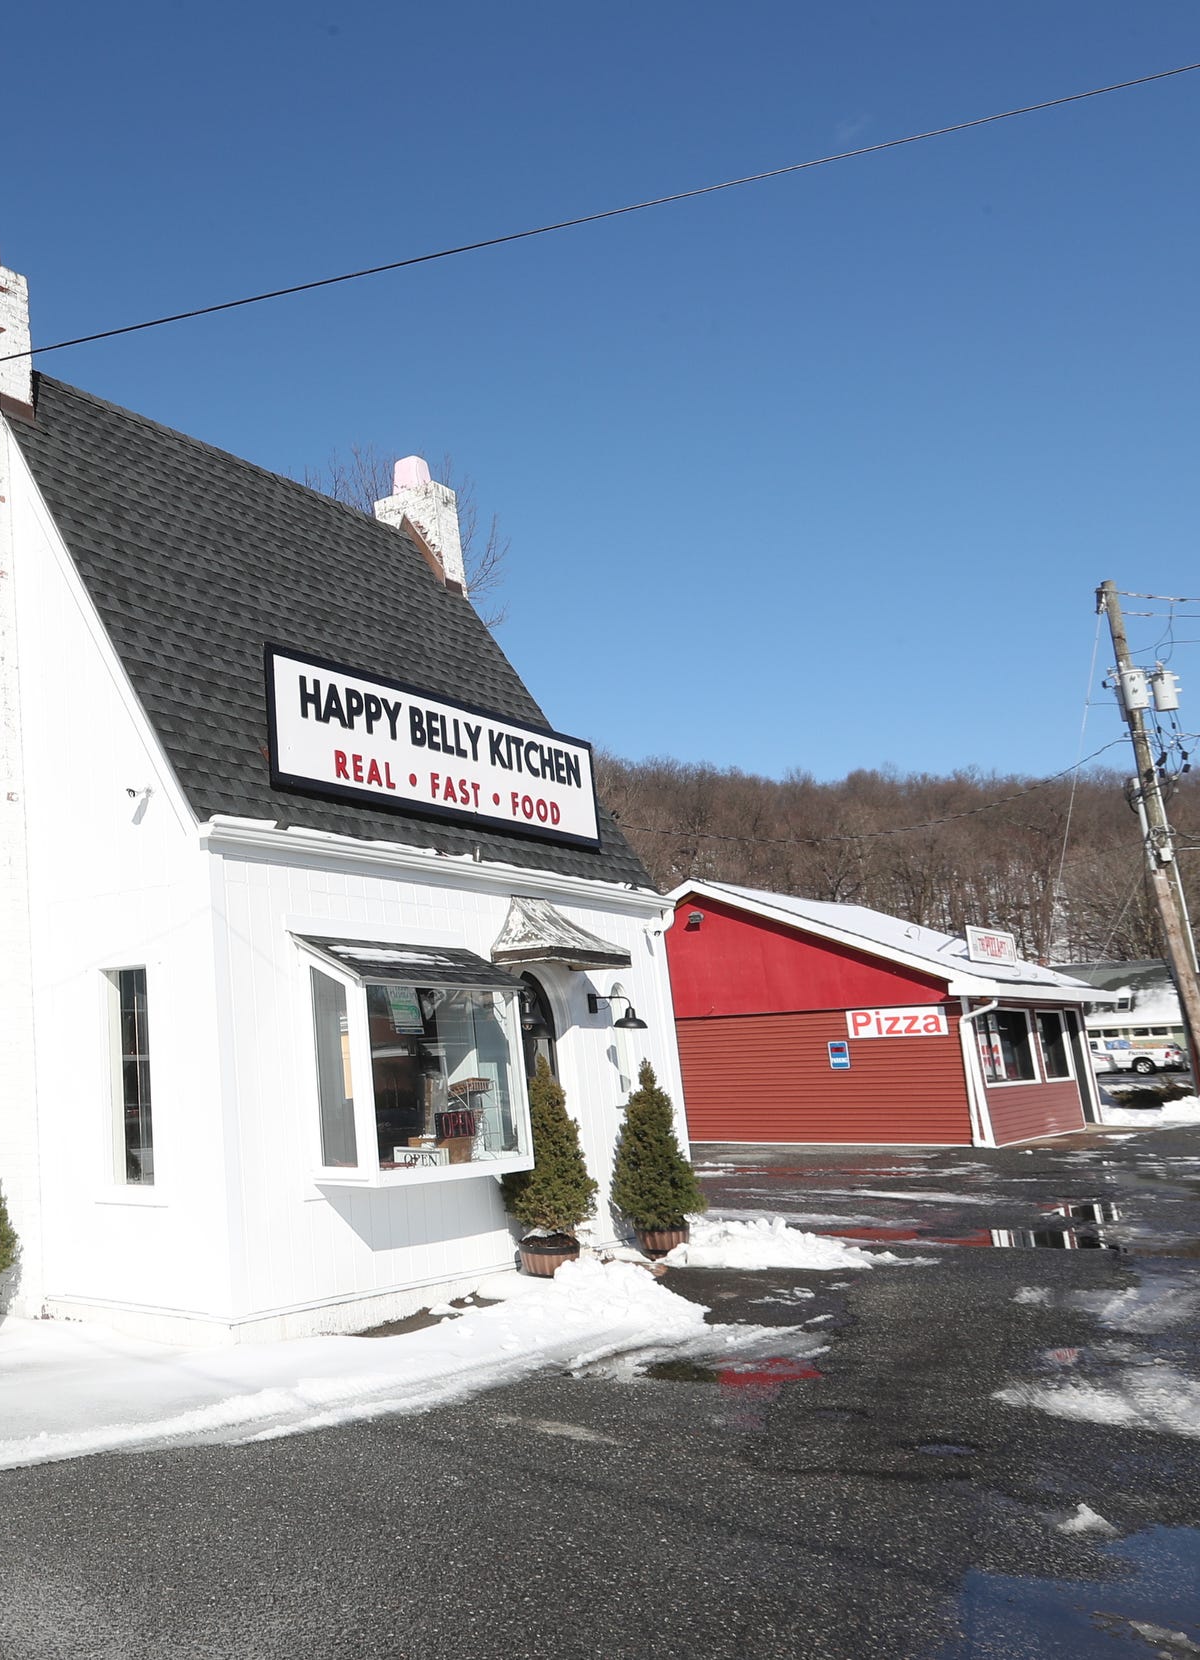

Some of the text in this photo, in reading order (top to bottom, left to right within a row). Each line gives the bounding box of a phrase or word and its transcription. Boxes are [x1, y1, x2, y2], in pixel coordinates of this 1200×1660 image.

[299, 675, 582, 788] HAPPY BELLY KITCHEN
[334, 750, 561, 825] REAL FAST FOOD
[851, 1011, 942, 1036] Pizza
[442, 1110, 475, 1138] OPEN
[403, 1153, 438, 1169] OPEN
